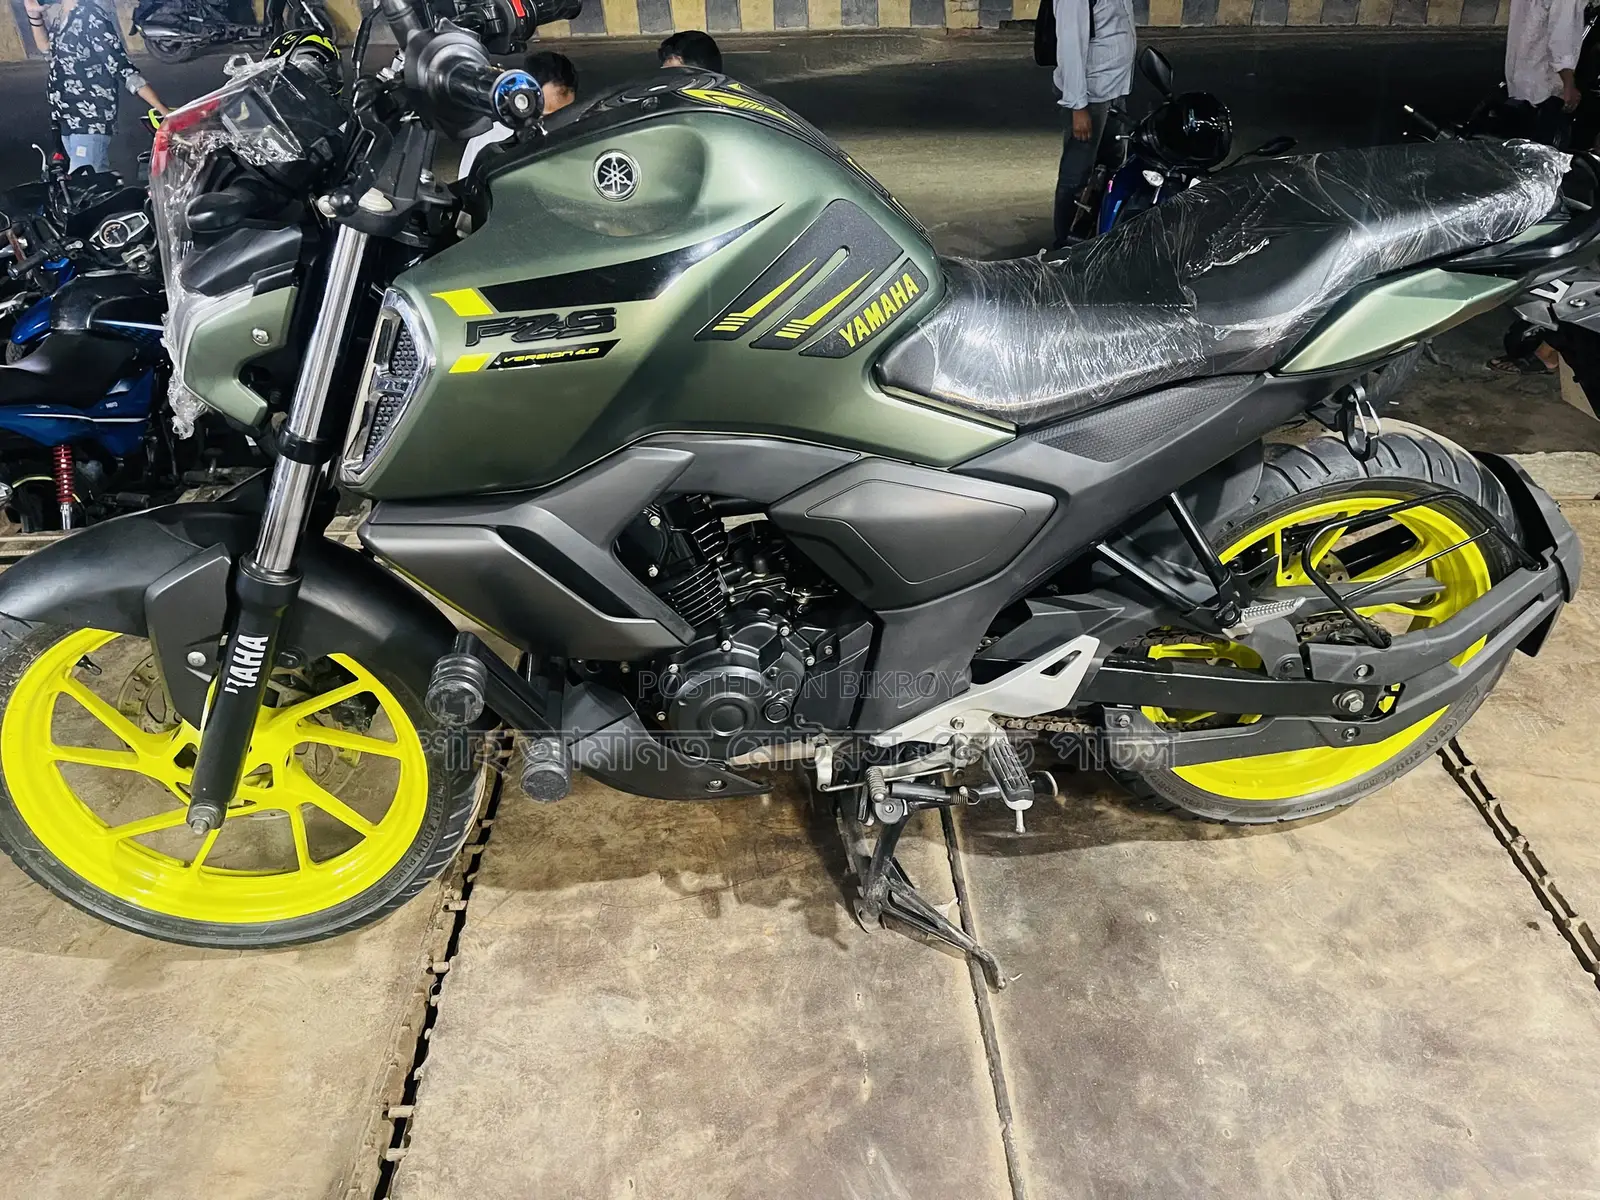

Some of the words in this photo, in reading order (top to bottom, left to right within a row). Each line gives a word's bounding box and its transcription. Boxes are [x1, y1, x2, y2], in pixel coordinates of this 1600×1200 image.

[838, 272, 920, 348] YAMAHA
[503, 350, 574, 363] VERSION
[575, 346, 600, 357] 4.0
